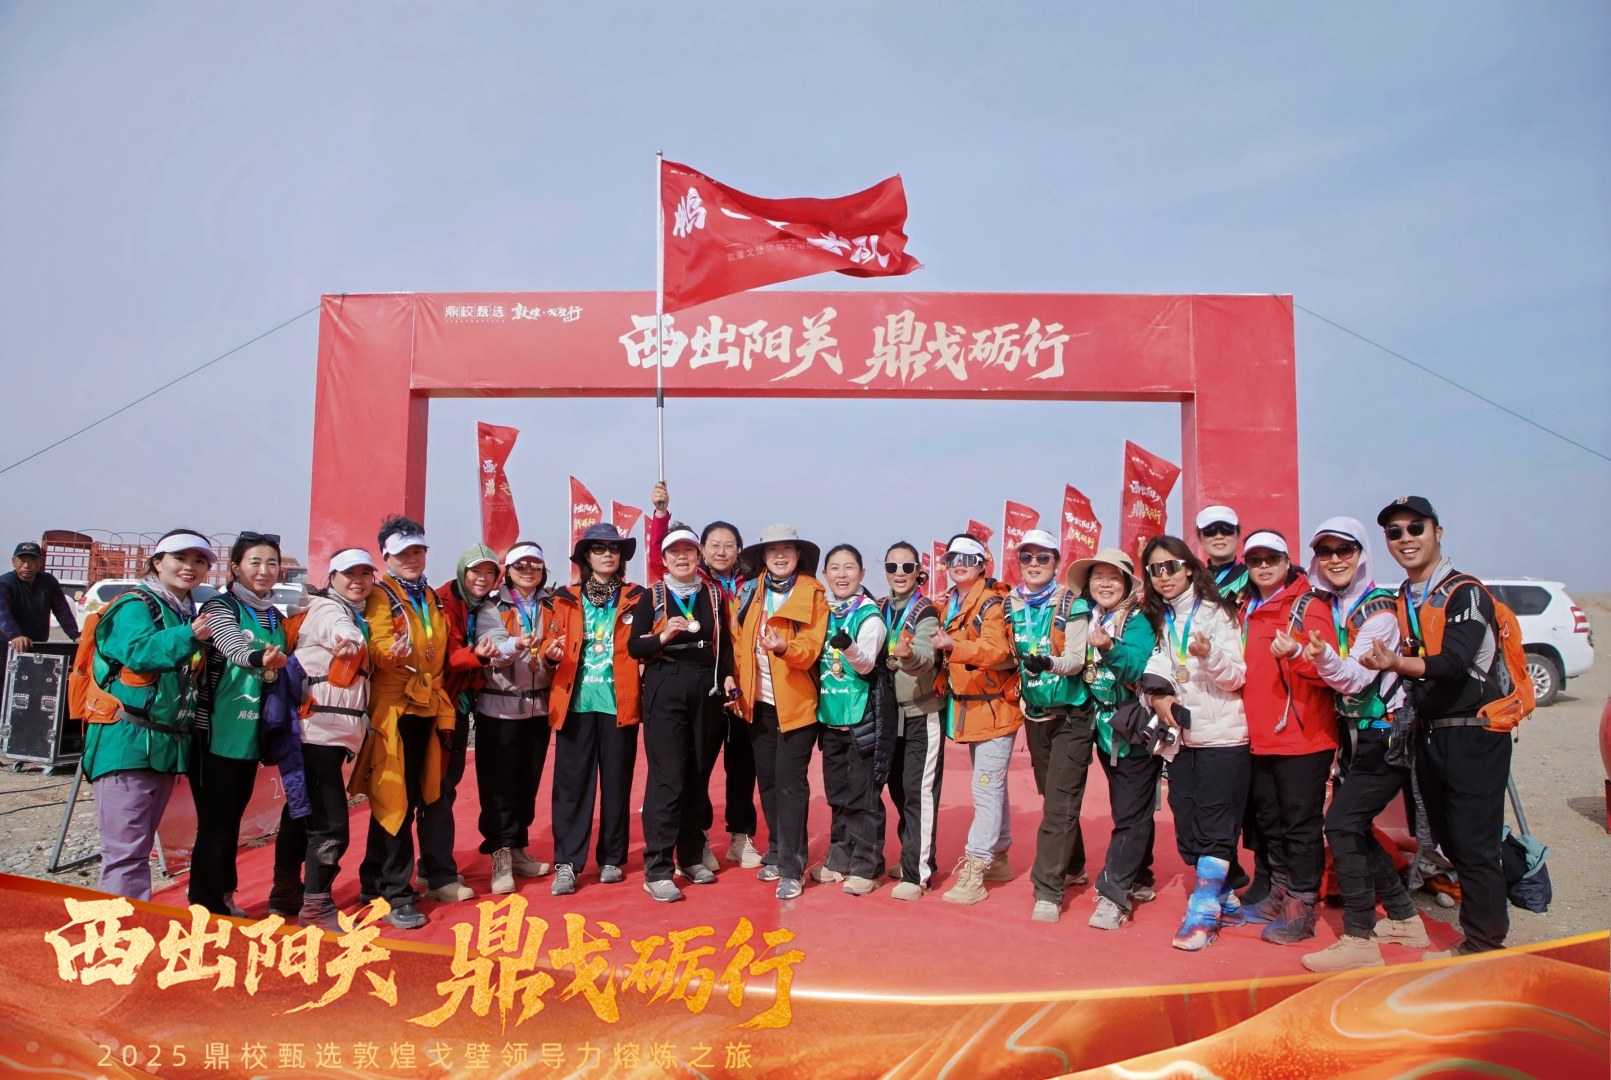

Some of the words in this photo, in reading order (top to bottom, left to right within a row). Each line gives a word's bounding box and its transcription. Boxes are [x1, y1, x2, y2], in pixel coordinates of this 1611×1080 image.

[618, 306, 844, 383] 西出阳关
[847, 308, 1071, 387] 鼎戈砺行
